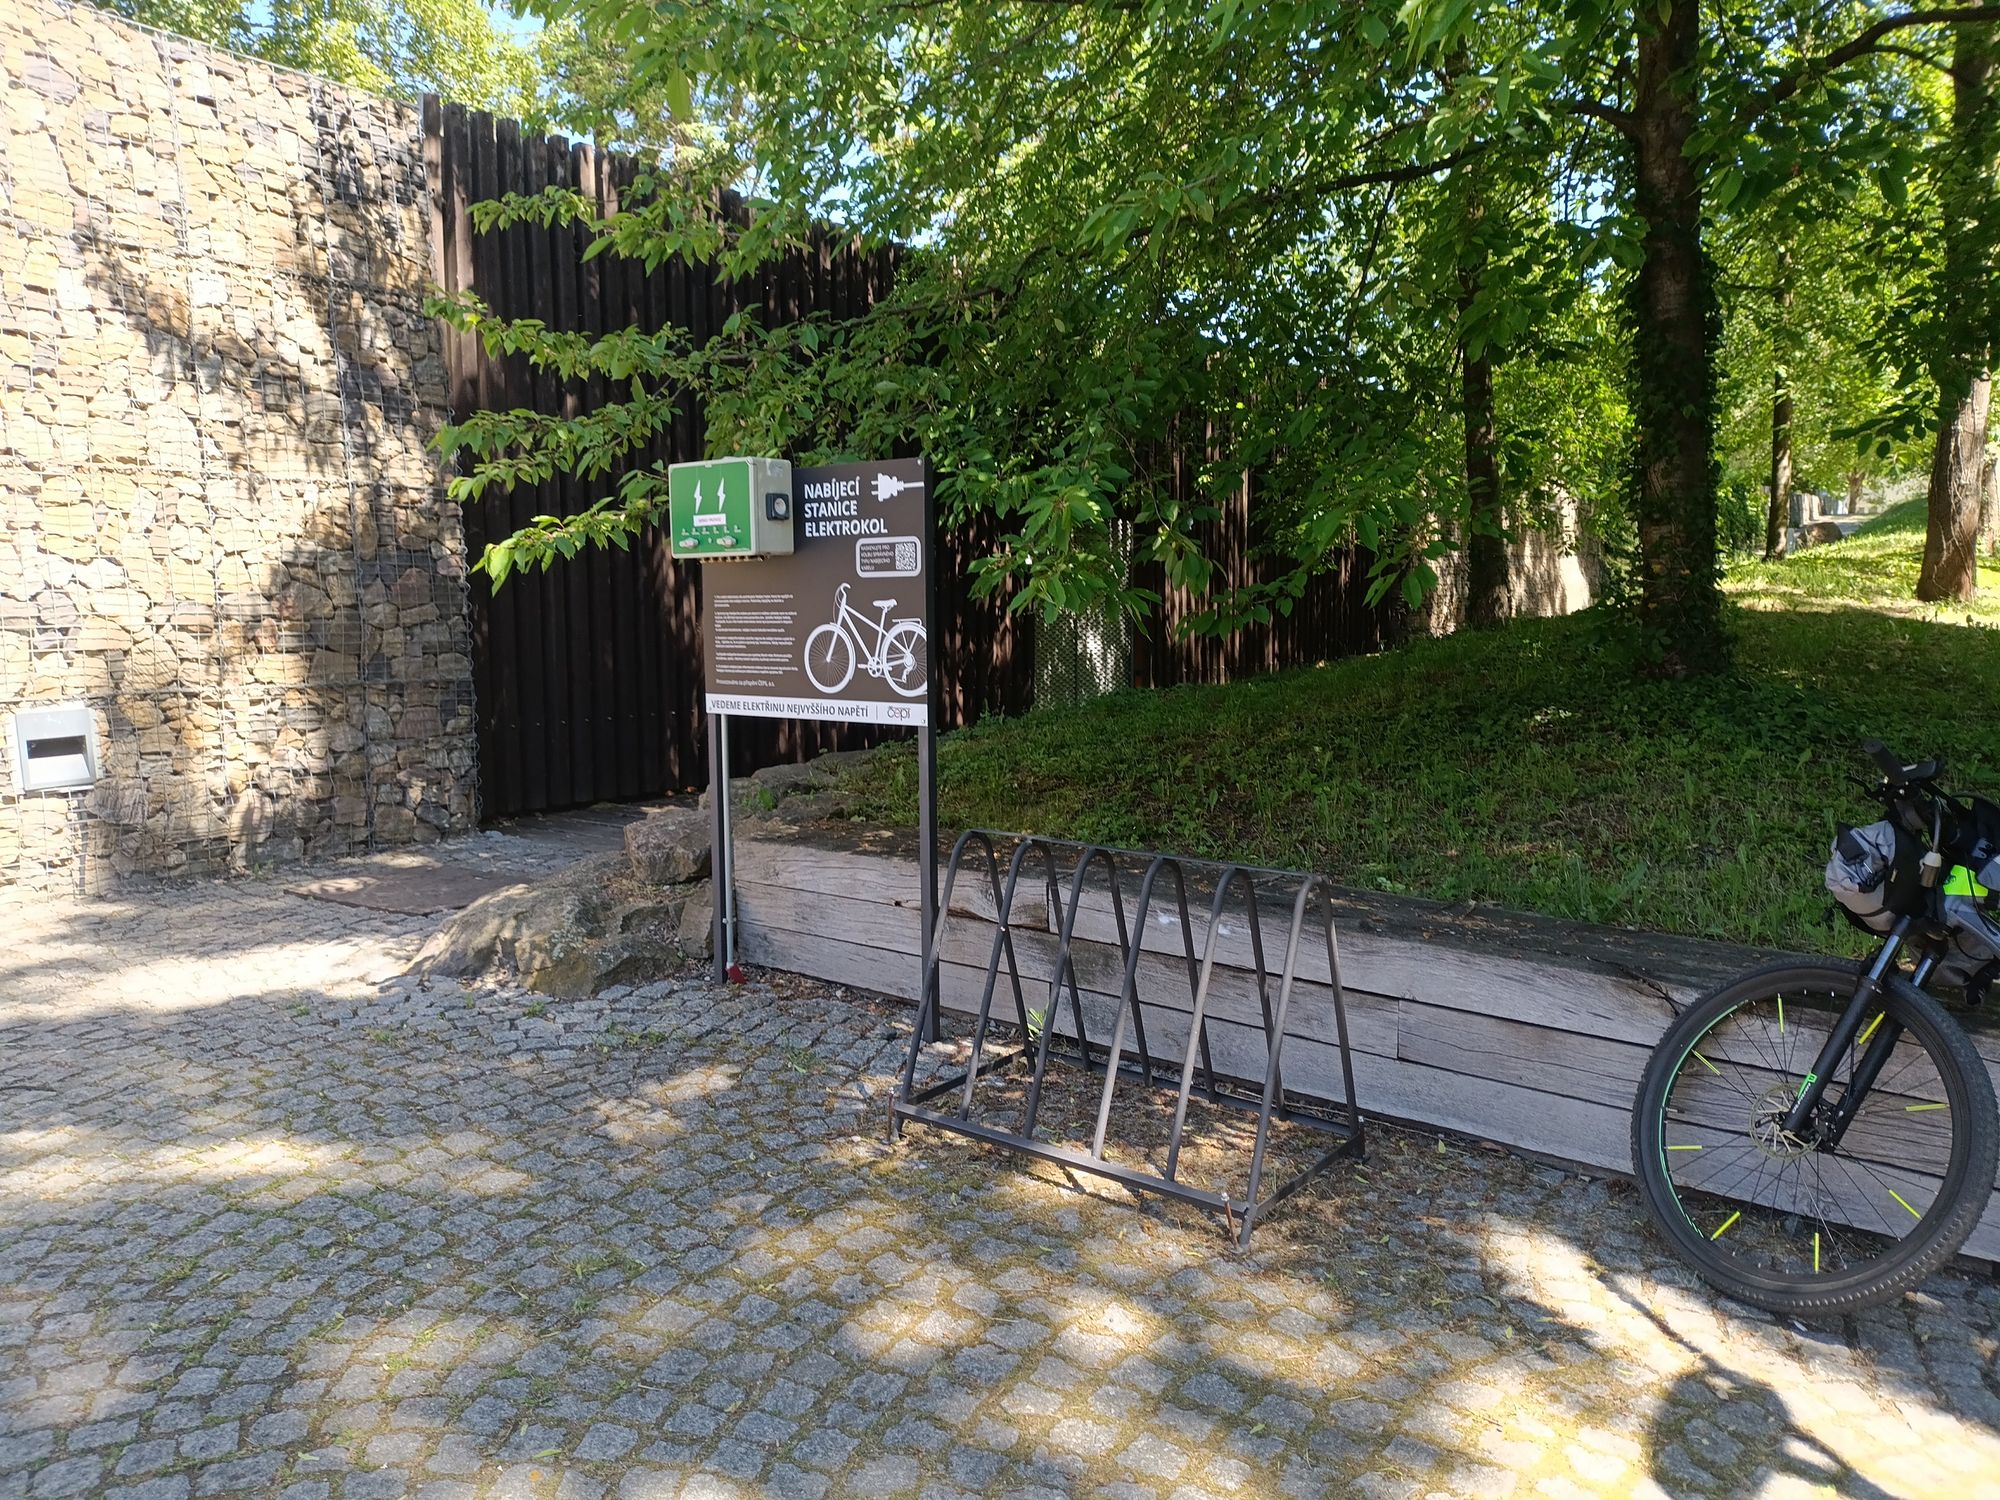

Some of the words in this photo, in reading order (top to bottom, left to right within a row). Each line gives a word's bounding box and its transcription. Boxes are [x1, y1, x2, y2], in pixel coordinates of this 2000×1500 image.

[804, 476, 860, 500] NABÍJECÍ
[804, 500, 858, 518] STANICE
[805, 518, 888, 537] ELEKTROKOL
[712, 700, 741, 710] VEDEME
[743, 701, 785, 713] ELEKTŘINU
[787, 703, 835, 716] NEJVYŠŠÍHO
[838, 705, 869, 717] NAPĚTÍ
